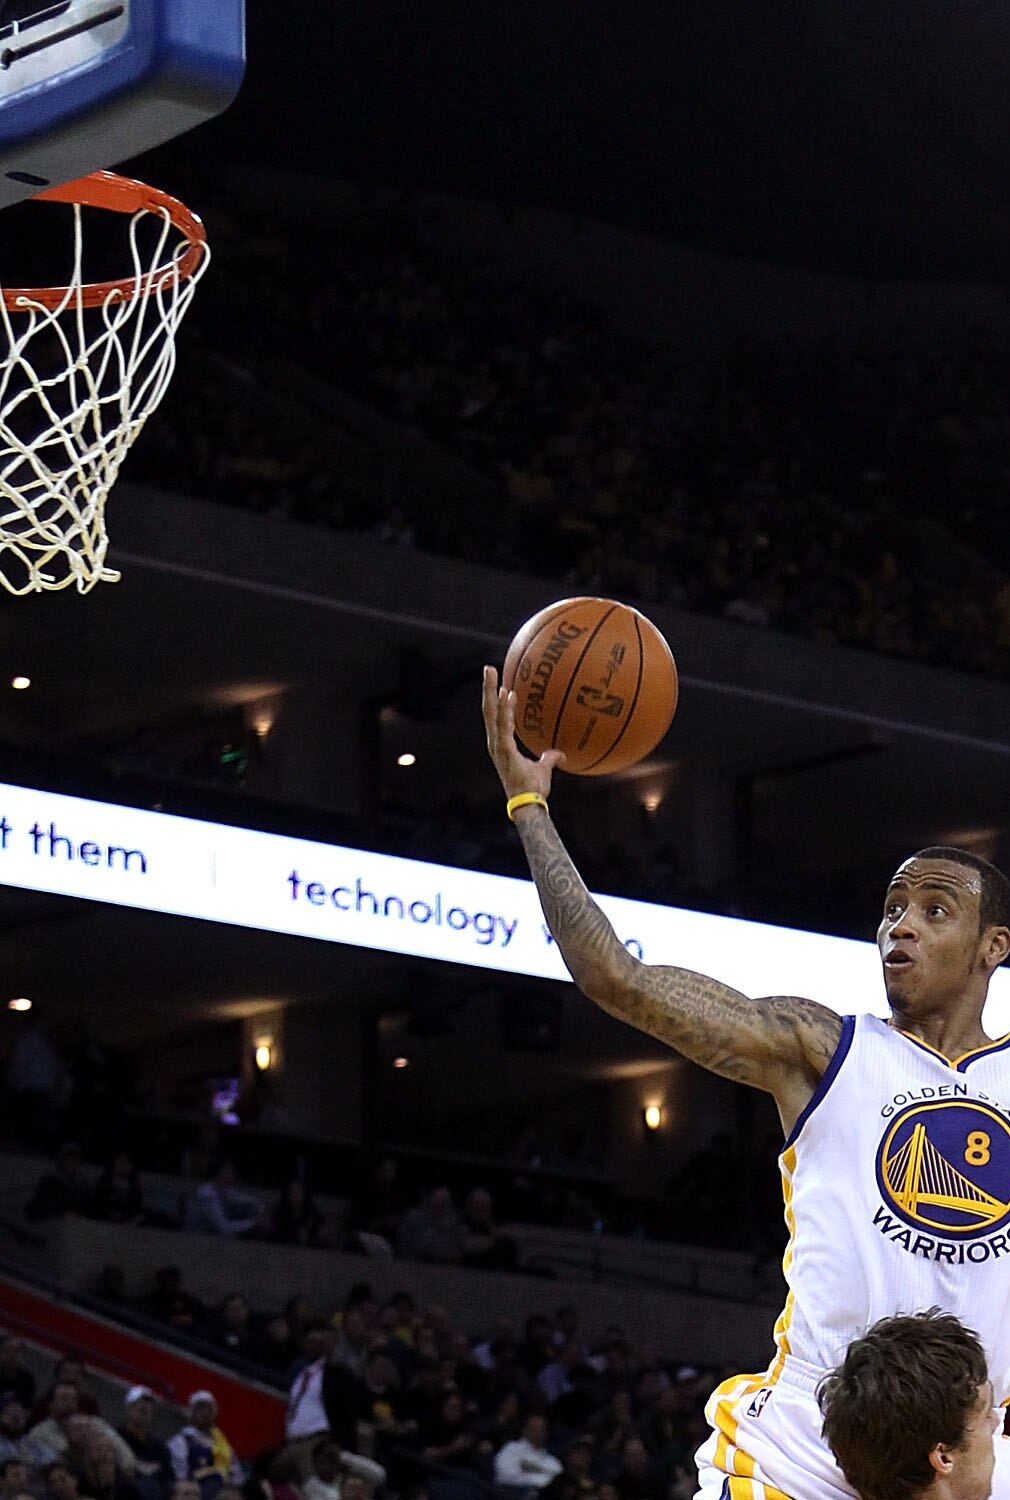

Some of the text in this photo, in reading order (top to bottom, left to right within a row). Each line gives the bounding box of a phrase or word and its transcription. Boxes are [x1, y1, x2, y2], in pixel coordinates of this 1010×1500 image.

[29, 821, 147, 874] them
[287, 869, 518, 948] technology
[880, 1083, 968, 1118] GOLDEN
[964, 1130, 991, 1167] 8
